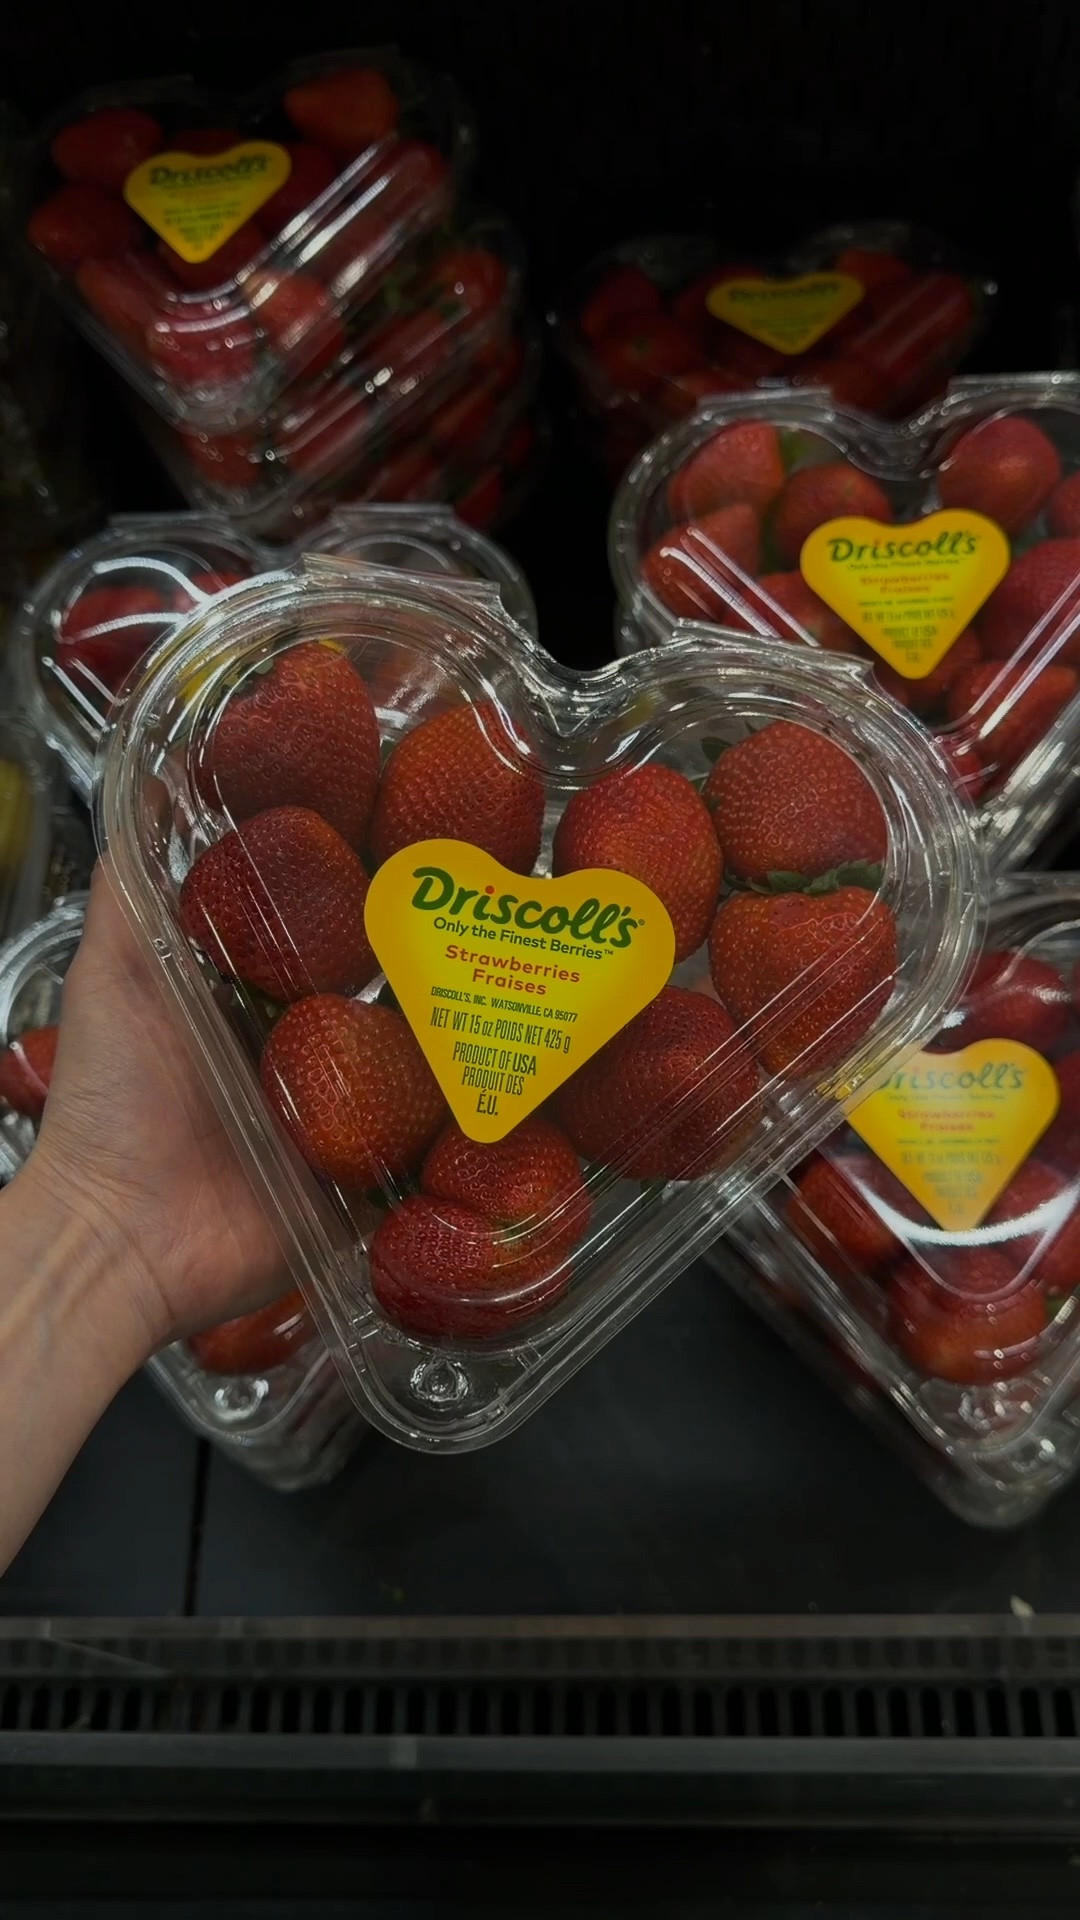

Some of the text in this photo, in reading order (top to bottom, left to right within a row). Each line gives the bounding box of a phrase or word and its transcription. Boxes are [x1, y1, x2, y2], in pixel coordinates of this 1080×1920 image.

[827, 530, 978, 562] Driscoll's
[433, 916, 470, 937] Only
[471, 924, 497, 940] the
[500, 929, 547, 949] Finest
[445, 944, 581, 983] Strawberries
[472, 968, 547, 995] Fraises
[430, 1006, 571, 1054] NET WT 15 oz POIDS NET 425 g
[543, 1007, 553, 1019] CA
[554, 1010, 578, 1023] 95077
[453, 1041, 537, 1076] PRODUCT OF USA
[461, 1065, 525, 1096] PRODUIT DES
[877, 1061, 1025, 1090] riscoll's
